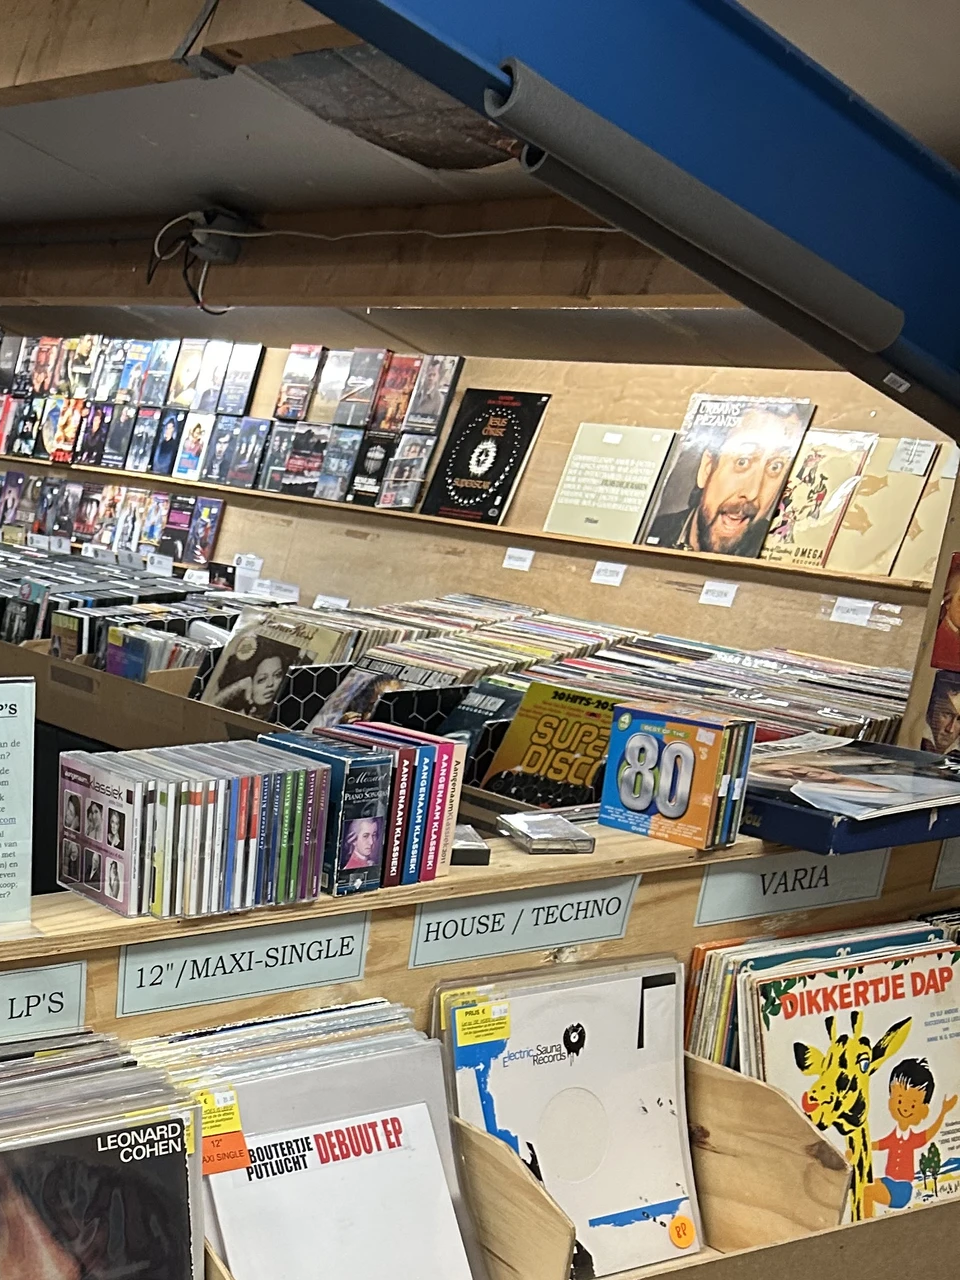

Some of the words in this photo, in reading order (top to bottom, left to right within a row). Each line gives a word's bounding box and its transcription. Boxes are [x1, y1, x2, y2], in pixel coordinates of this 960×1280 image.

[794, 548, 823, 559] OMEGA
[11, 740, 20, 748] de
[530, 714, 612, 758] SUPE
[0, 767, 9, 775] de
[434, 754, 449, 820] AANGENAAM
[620, 733, 695, 818] 80
[396, 759, 409, 826] AANGENAAM
[415, 757, 429, 823] AANGENAAM
[759, 864, 831, 898] VARIA
[423, 909, 507, 943] HOUSE
[531, 893, 624, 930] TECHNO
[7, 990, 66, 1023] LP'S
[780, 972, 906, 1020] DIKKERTJE
[910, 966, 954, 998] DAP
[533, 1052, 566, 1066] Records
[536, 1043, 562, 1056] Sauna
[97, 1123, 182, 1152] LEONARD
[119, 1138, 183, 1163] COHEN
[249, 1135, 313, 1163] BOUTERTJE
[313, 1122, 380, 1165] DEBUUT
[381, 1116, 403, 1150] EP
[203, 1155, 214, 1163] AXI
[216, 1150, 244, 1160] SINGLE
[246, 1154, 309, 1182] PUTLUCHT
